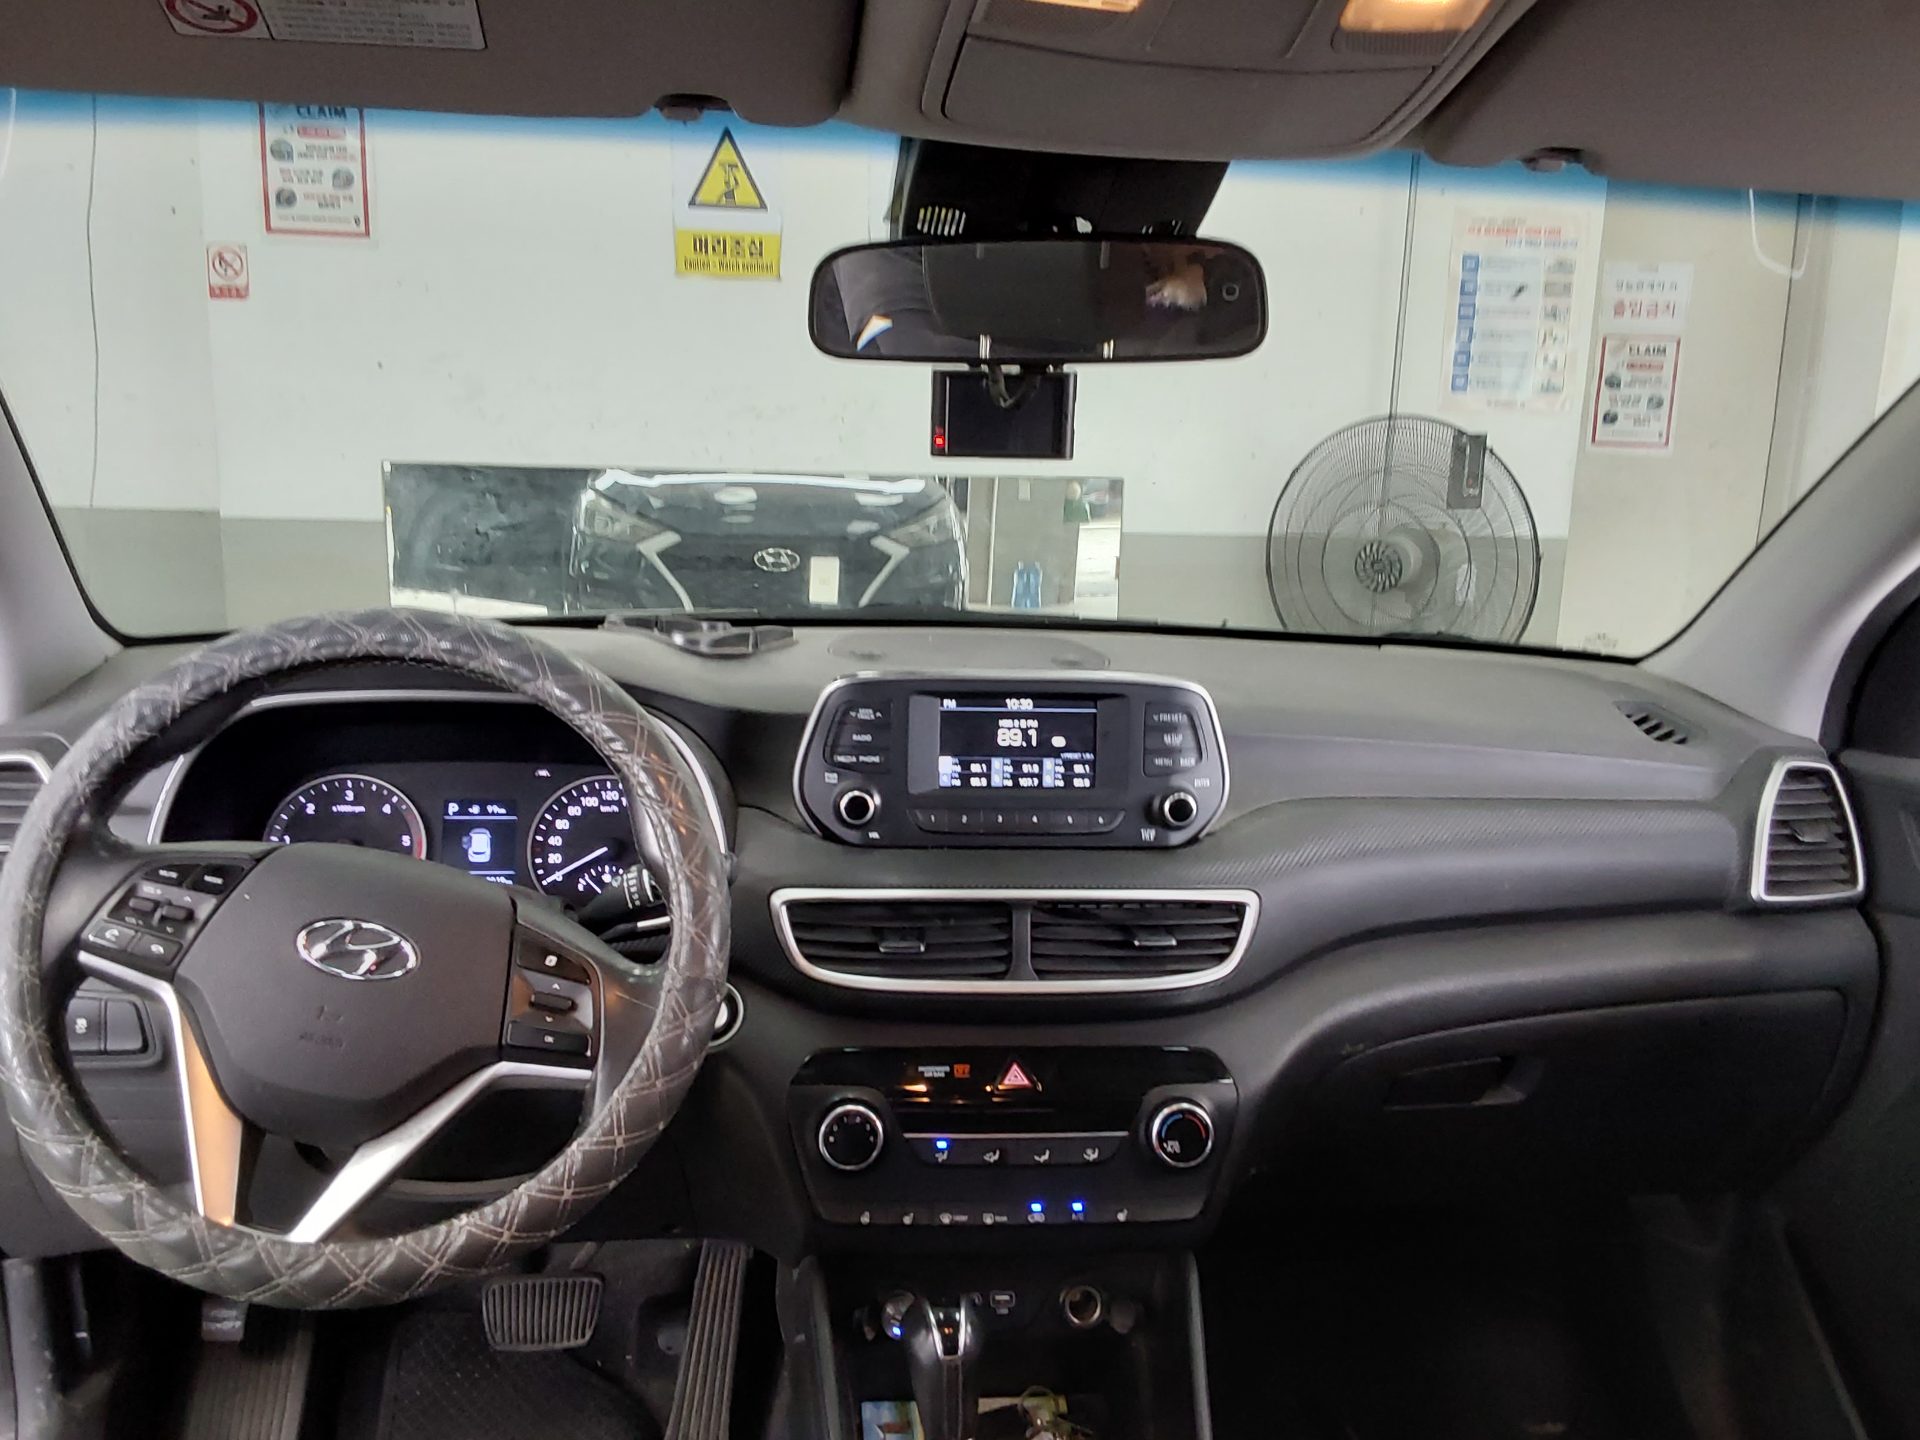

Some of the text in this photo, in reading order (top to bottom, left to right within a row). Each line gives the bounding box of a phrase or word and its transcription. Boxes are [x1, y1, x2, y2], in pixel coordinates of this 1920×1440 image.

[297, 105, 346, 119] CLAIM
[693, 236, 763, 257] 머리조심
[684, 257, 711, 271] Caution
[719, 259, 740, 272] Watch
[1628, 345, 1667, 356] CLAIM
[852, 733, 873, 742] RADIO
[997, 728, 1037, 747] 89.1
[345, 790, 354, 801] 3
[600, 790, 620, 801] 120
[580, 796, 599, 807] 100
[305, 803, 315, 814] 2
[382, 803, 392, 814] 4
[448, 802, 460, 816] P
[600, 804, 619, 813] km/h
[401, 835, 411, 847] 5
[547, 835, 563, 846] 40
[547, 852, 562, 864] 20
